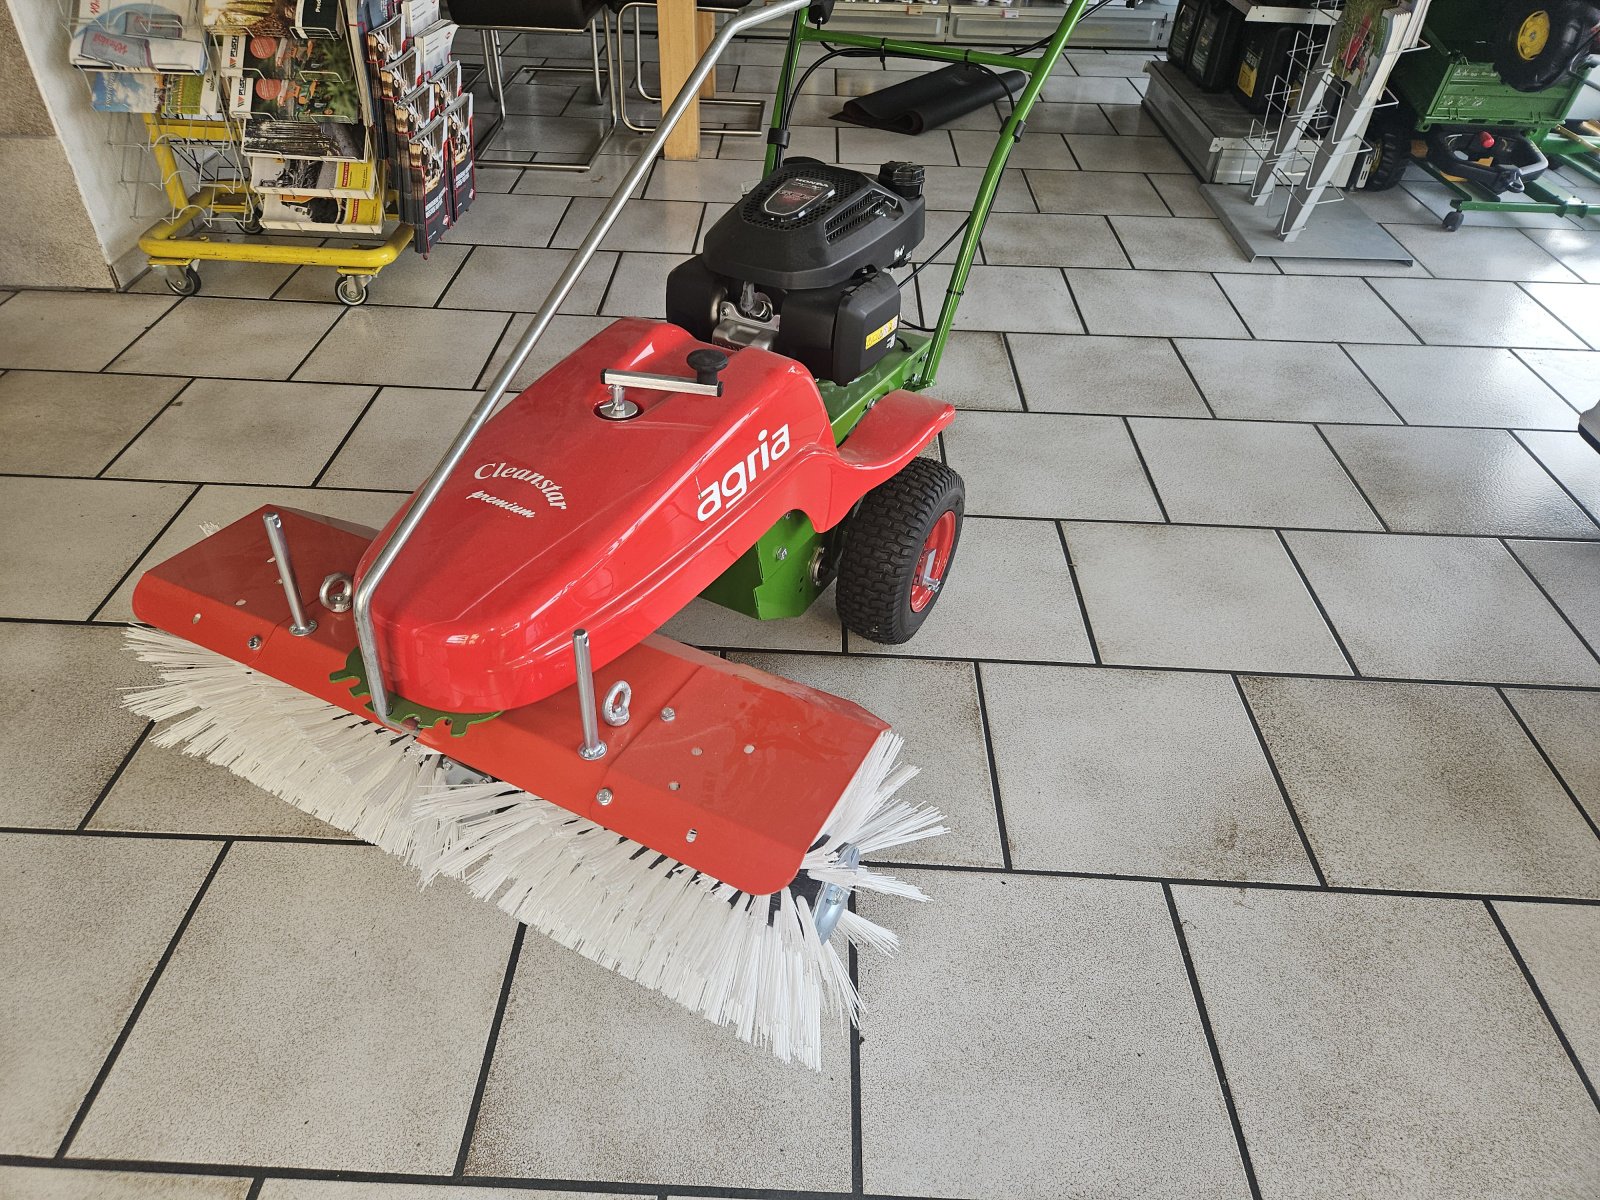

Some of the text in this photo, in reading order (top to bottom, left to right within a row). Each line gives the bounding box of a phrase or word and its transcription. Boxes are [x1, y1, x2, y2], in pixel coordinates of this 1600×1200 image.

[474, 462, 567, 509] Cleanstar
[697, 423, 790, 522] agria
[465, 490, 536, 518] premium
